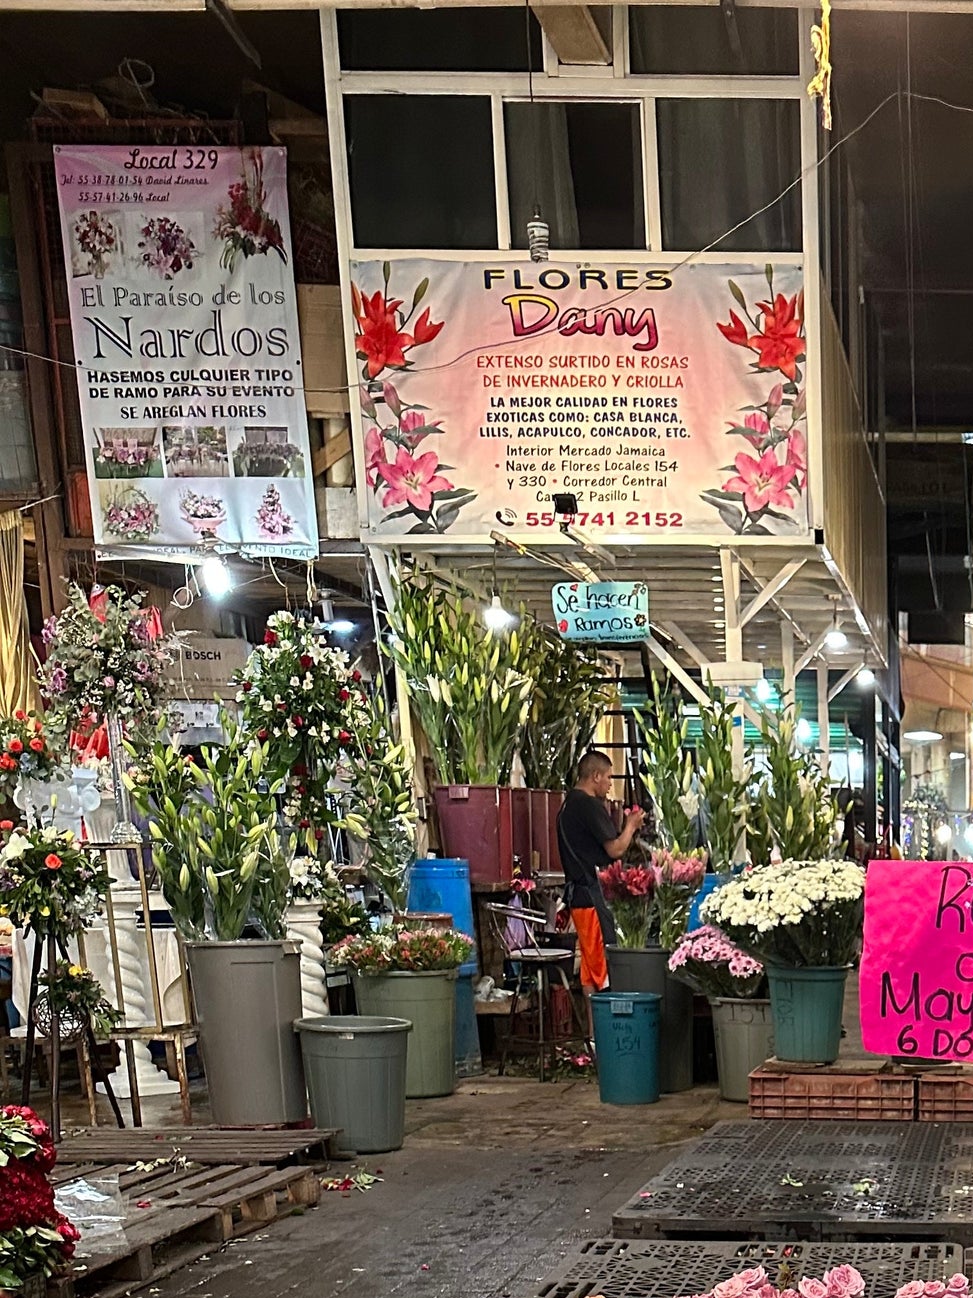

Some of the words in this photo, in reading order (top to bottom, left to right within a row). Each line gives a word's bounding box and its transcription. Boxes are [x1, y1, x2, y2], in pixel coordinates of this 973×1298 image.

[124, 149, 177, 169] Local
[183, 150, 218, 169] 329
[146, 175, 171, 185] David
[146, 192, 170, 202] Local
[484, 269, 672, 290] FLORES
[81, 285, 104, 307] El
[114, 286, 203, 307] Paraíso
[212, 284, 240, 305] de
[252, 283, 285, 305] los
[502, 294, 658, 350] Dany
[84, 309, 289, 358] Nardos
[477, 356, 543, 368] EXTENSO
[550, 356, 610, 368] SURTIDO
[616, 356, 635, 368] EN
[641, 357, 688, 369] ROSAS
[87, 371, 164, 383] HASEMOS
[170, 370, 250, 382] CULQUIER
[255, 369, 293, 381] TIPO
[483, 375, 500, 388] DE
[507, 375, 606, 388] INVERNADERO
[612, 375, 620, 387] Y
[627, 376, 683, 388] CRIOLLA
[89, 387, 109, 399] DE
[114, 387, 158, 399] RAMO
[163, 387, 201, 398] PARA
[207, 386, 227, 397] SU
[232, 386, 294, 397] EVENTO
[491, 397, 505, 407] LA
[510, 397, 551, 407] MEJOR
[556, 397, 607, 407] CALIDAD
[613, 397, 627, 406] EN
[633, 398, 678, 407] FLORES
[121, 407, 138, 419] SE
[143, 405, 206, 418] AREGLAN
[212, 405, 266, 418] FLORES
[487, 412, 544, 423] EXOTICAS
[550, 412, 589, 422] COMO:
[594, 412, 624, 422] CASA
[630, 413, 682, 424] BLANCA,
[480, 427, 513, 438] LILIS,
[518, 427, 585, 438] ACAPULCO,
[590, 427, 660, 439] CONCADOR,
[666, 428, 690, 438] ETC.
[506, 445, 553, 457] Interior
[559, 445, 611, 456] Mercado
[616, 444, 665, 457] Jamaica
[506, 460, 536, 471] Nave
[542, 461, 556, 471] de
[562, 460, 600, 472] Flores
[605, 460, 649, 471] Locales
[655, 461, 678, 471] 154
[507, 479, 514, 489] y
[519, 476, 546, 487] 330
[563, 476, 617, 487] Corredor
[622, 475, 667, 487] Central
[590, 491, 627, 501] Pasillo
[633, 492, 640, 501] L
[526, 512, 554, 526] 55
[626, 512, 683, 527] 2152
[557, 586, 578, 614] Se
[586, 586, 639, 610] hacen
[185, 652, 221, 660] BOSCH
[897, 1025, 918, 1054] 6
